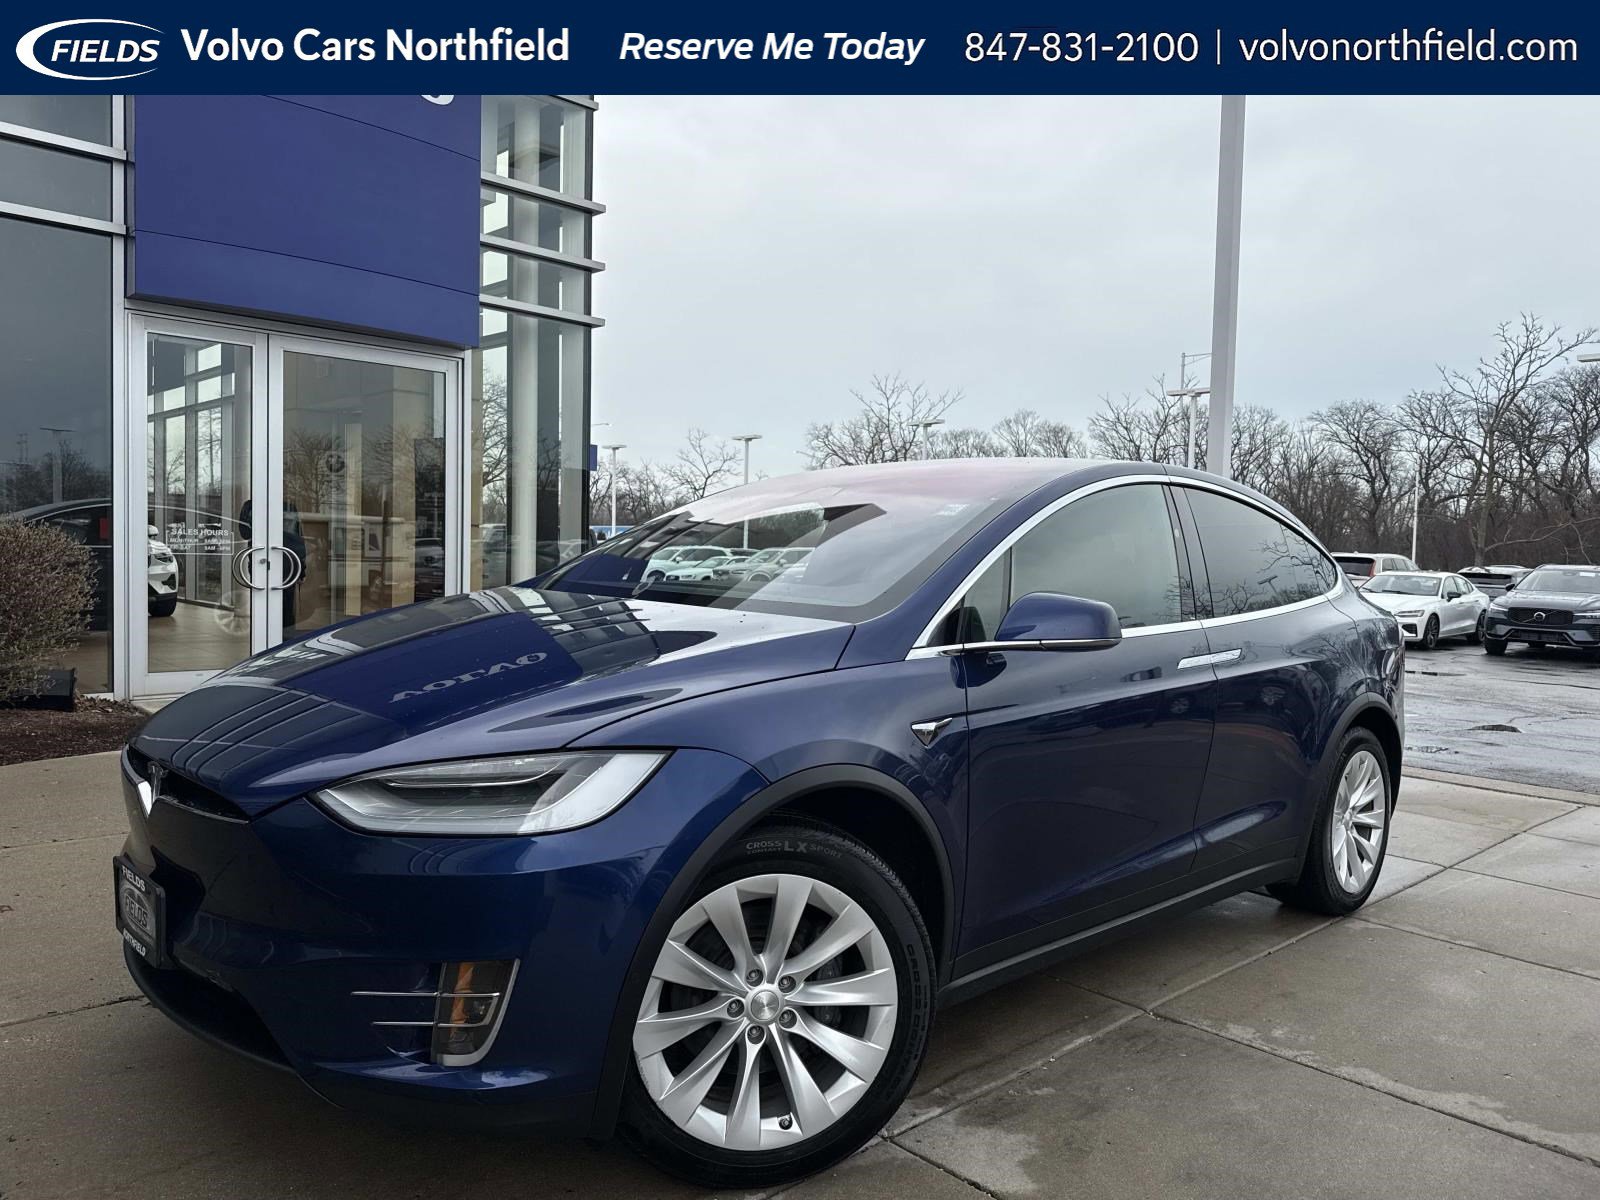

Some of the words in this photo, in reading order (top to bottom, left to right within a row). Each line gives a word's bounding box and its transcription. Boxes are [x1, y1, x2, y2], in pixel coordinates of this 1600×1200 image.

[170, 528, 198, 536] SALES
[200, 528, 229, 536] HOURS
[745, 840, 782, 850] CROSS
[783, 840, 808, 853] LX
[121, 864, 146, 892] FIELDS
